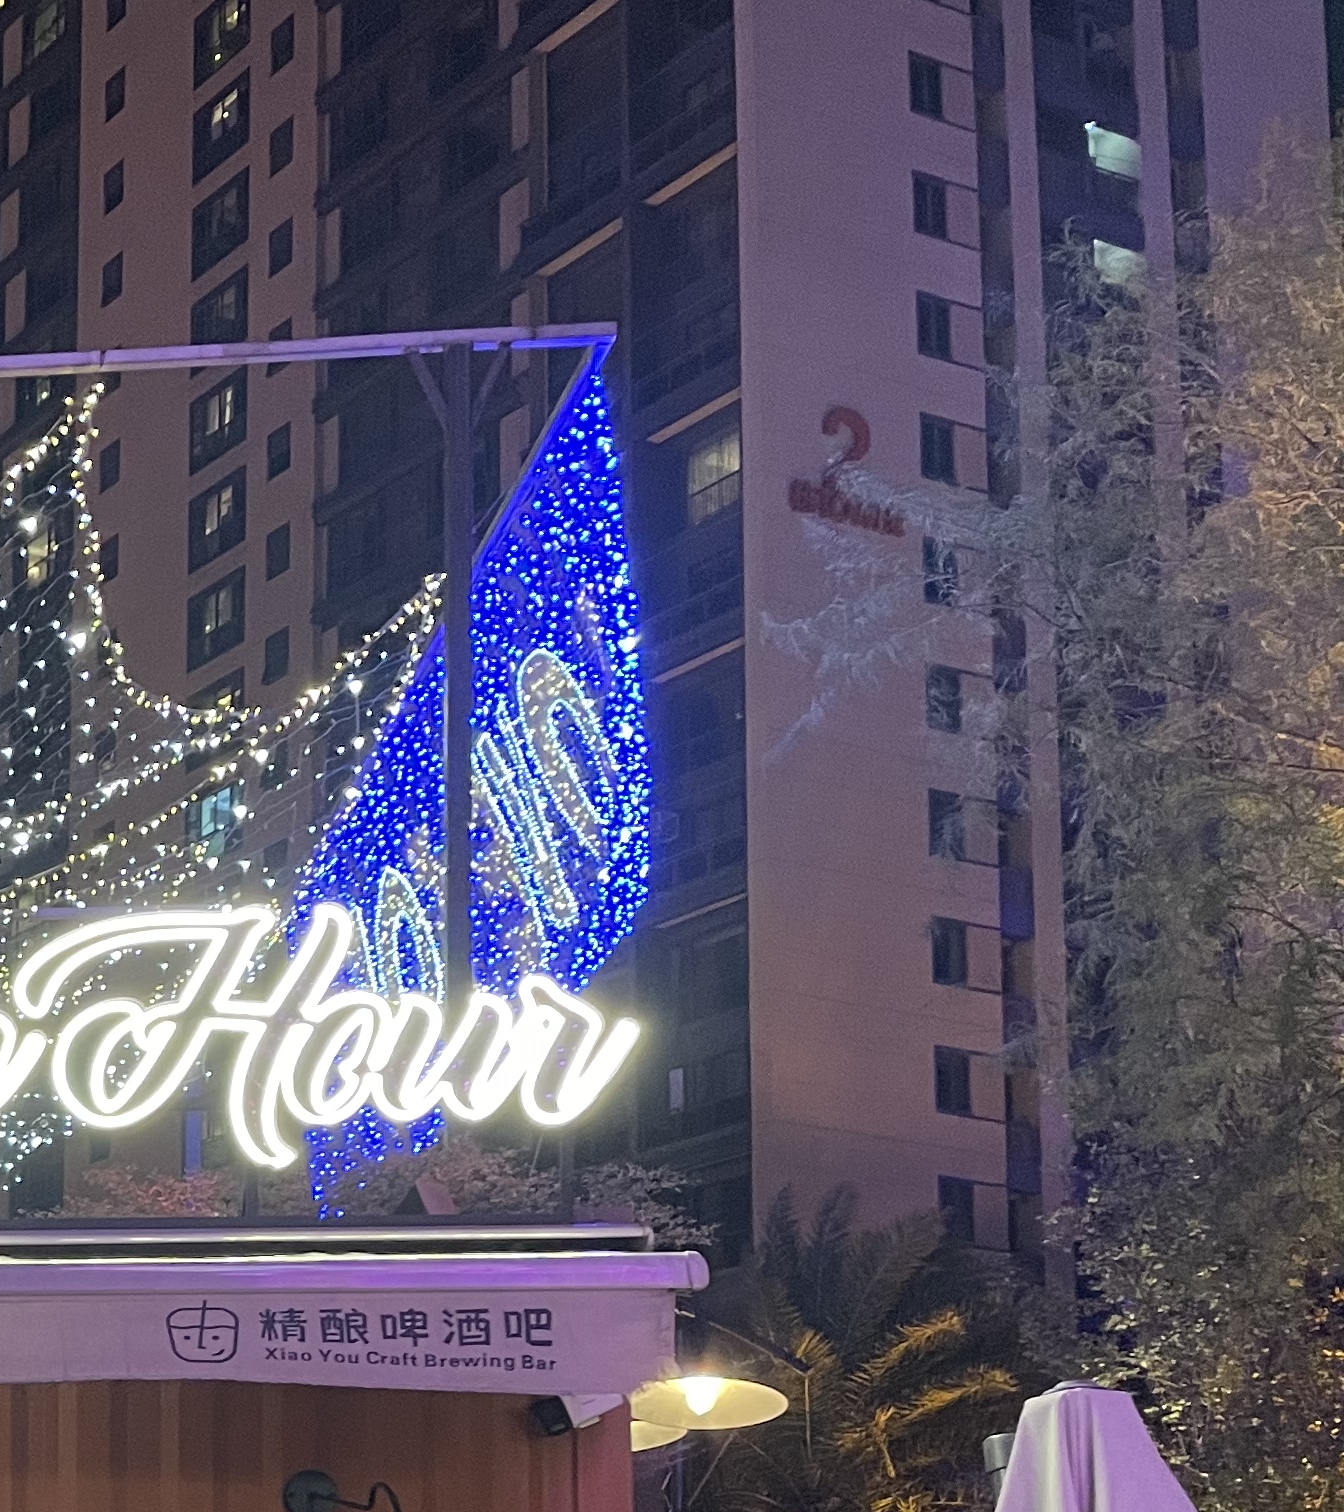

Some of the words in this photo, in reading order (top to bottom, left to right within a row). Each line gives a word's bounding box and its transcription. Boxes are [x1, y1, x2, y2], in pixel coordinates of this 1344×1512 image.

[14, 902, 645, 1173] Hour
[258, 1308, 554, 1347] 精酿啤酒吧
[265, 1347, 312, 1362] Xiao
[319, 1348, 359, 1364] You
[366, 1351, 418, 1367] Craft
[424, 1354, 516, 1371] Brewing
[522, 1355, 557, 1371] Bar
